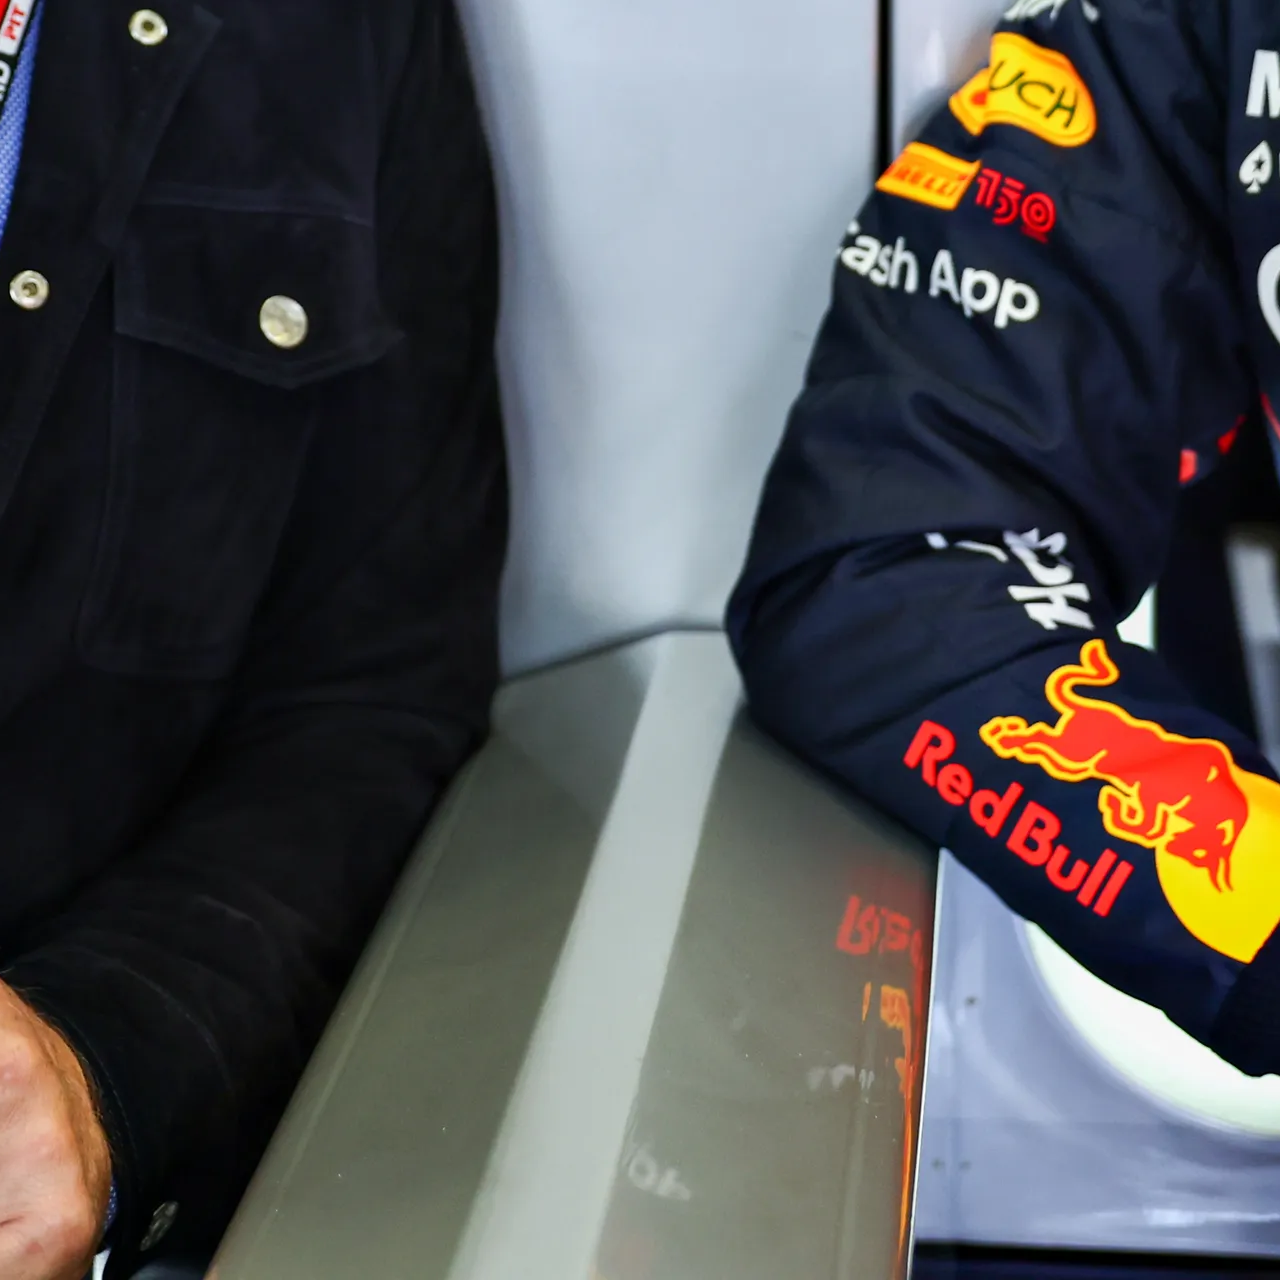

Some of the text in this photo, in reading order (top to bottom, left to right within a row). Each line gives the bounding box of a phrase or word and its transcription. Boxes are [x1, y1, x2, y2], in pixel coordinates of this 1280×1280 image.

[5, 4, 26, 40] PIT
[837, 221, 1040, 329] ash App
[903, 720, 1134, 917] Red Bull
